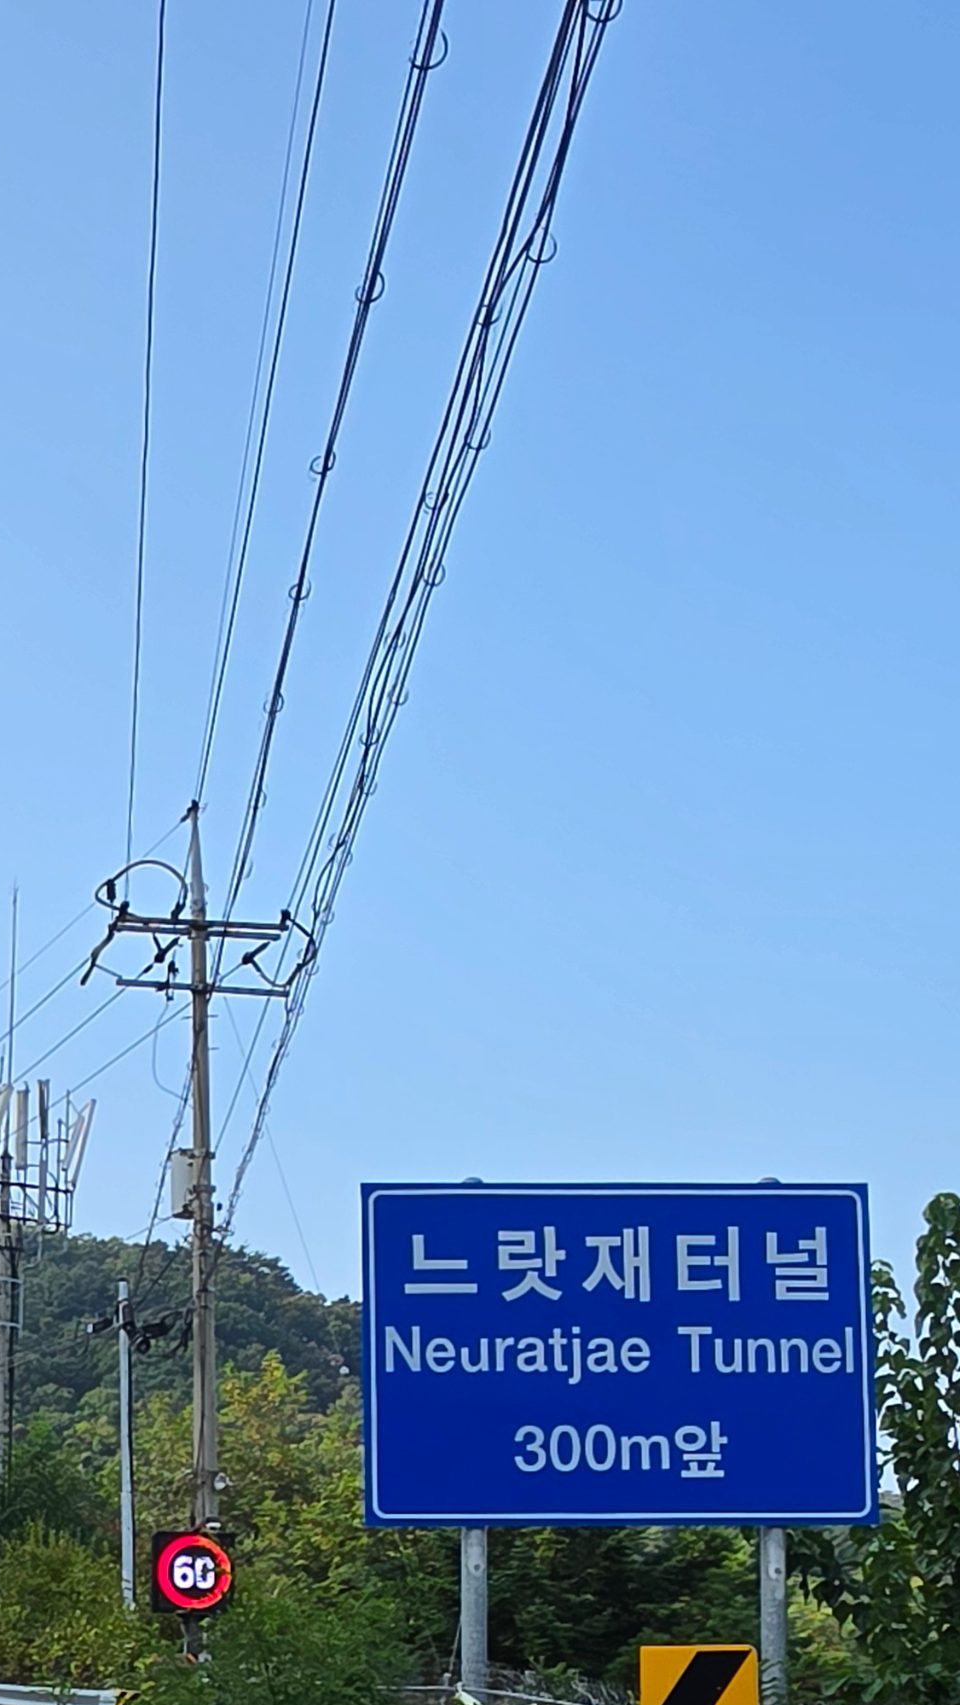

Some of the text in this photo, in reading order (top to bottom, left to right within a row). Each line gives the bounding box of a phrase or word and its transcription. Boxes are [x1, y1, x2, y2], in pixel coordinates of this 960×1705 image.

[404, 1226, 830, 1302] 느랏재터널
[385, 1326, 855, 1384] Neuratjae Tunnel
[514, 1421, 728, 1478] 300m앞
[173, 1555, 216, 1590] 60
